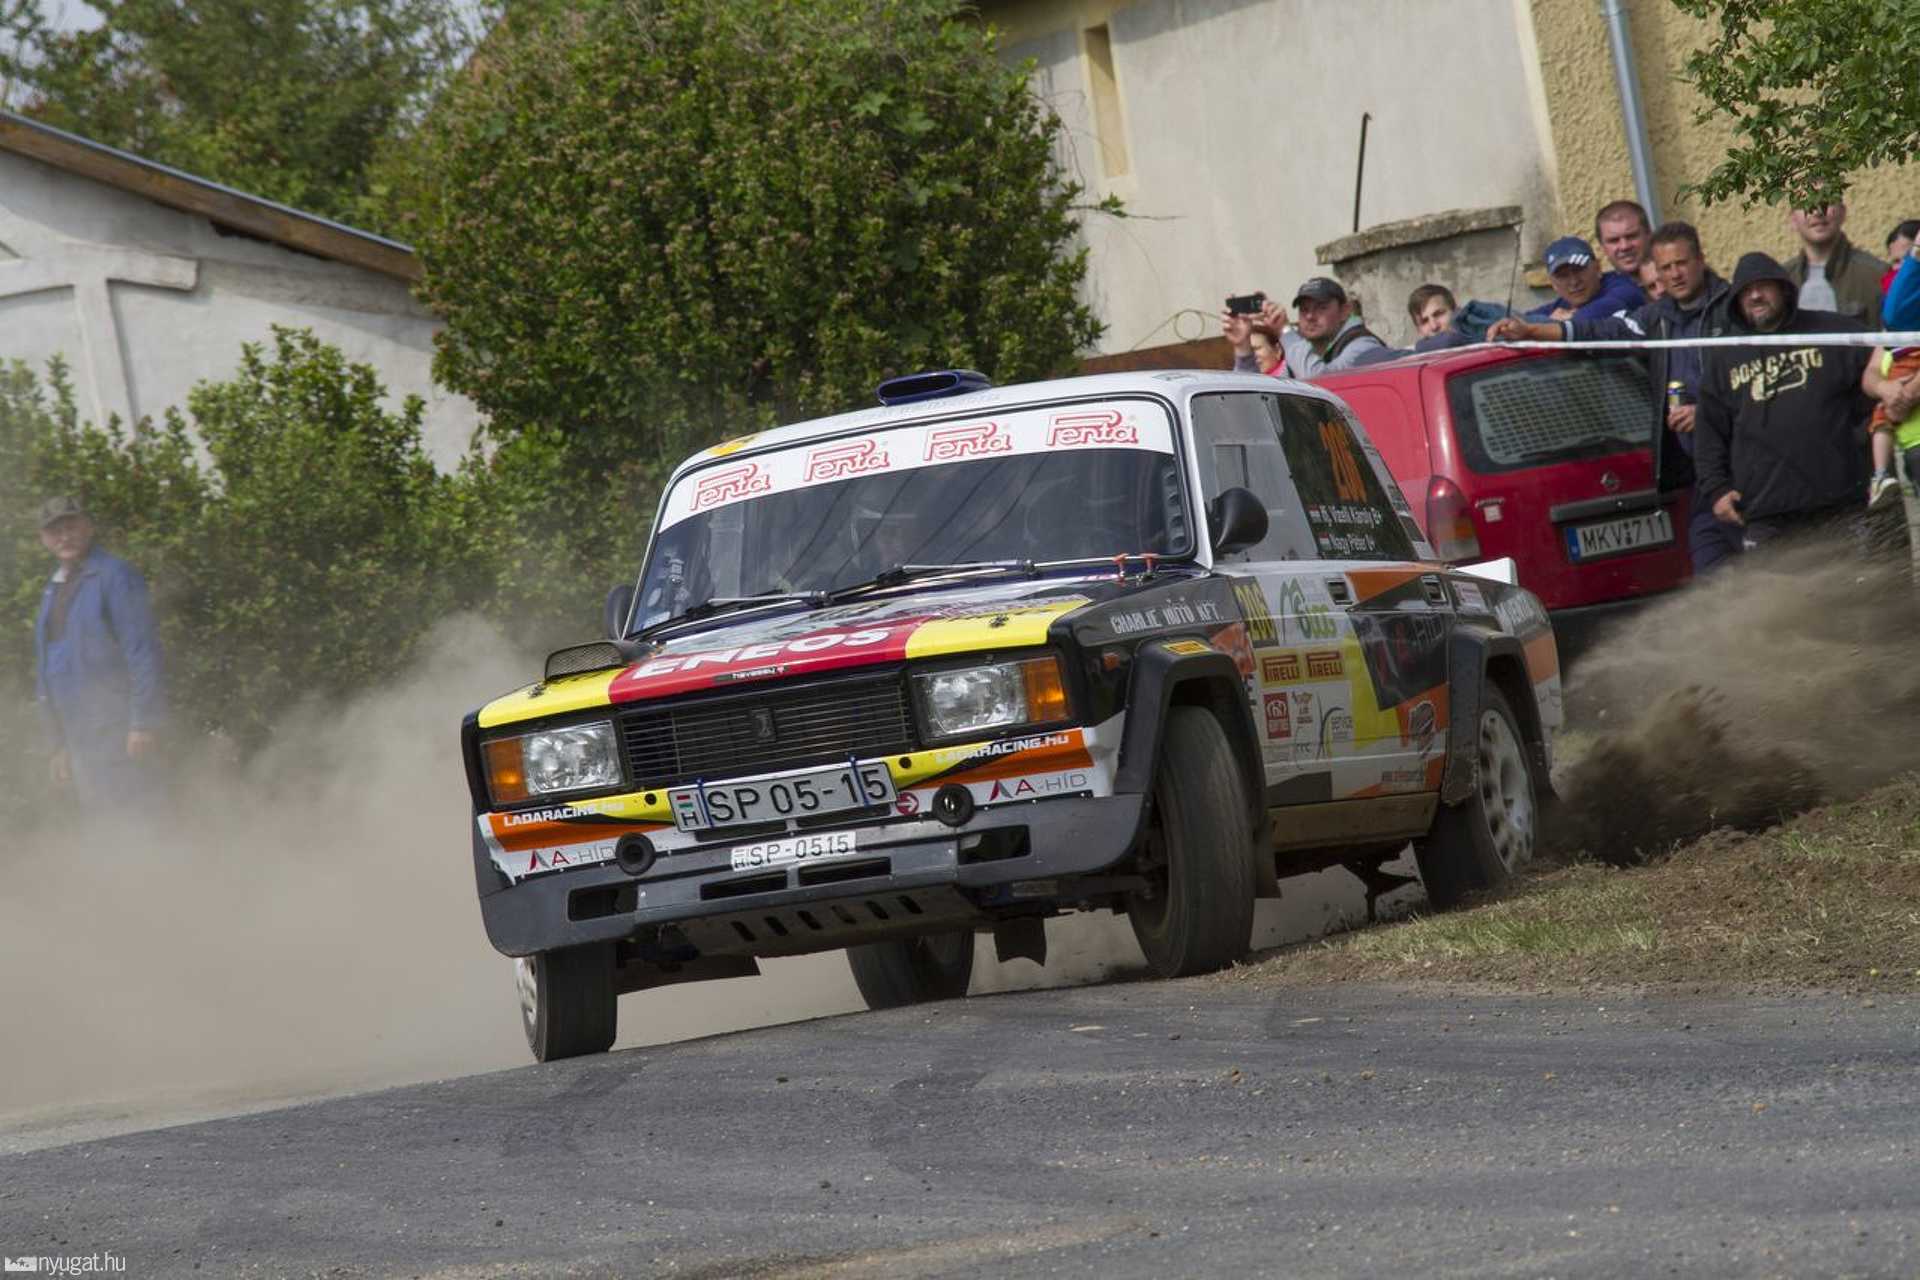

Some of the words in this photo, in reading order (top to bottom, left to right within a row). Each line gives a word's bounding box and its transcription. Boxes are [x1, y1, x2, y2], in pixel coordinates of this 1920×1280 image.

[923, 422, 1012, 462] Penta
[1046, 410, 1138, 447] Penta
[804, 440, 890, 482] Penta
[690, 463, 771, 511] Penta
[1110, 609, 1162, 634] CHARLIE
[632, 627, 893, 681] ENEOS
[1262, 655, 1299, 683] PIRELLI
[1306, 651, 1343, 678] PIRELLI
[707, 788, 760, 822] SP
[750, 834, 849, 866] SP-0515
